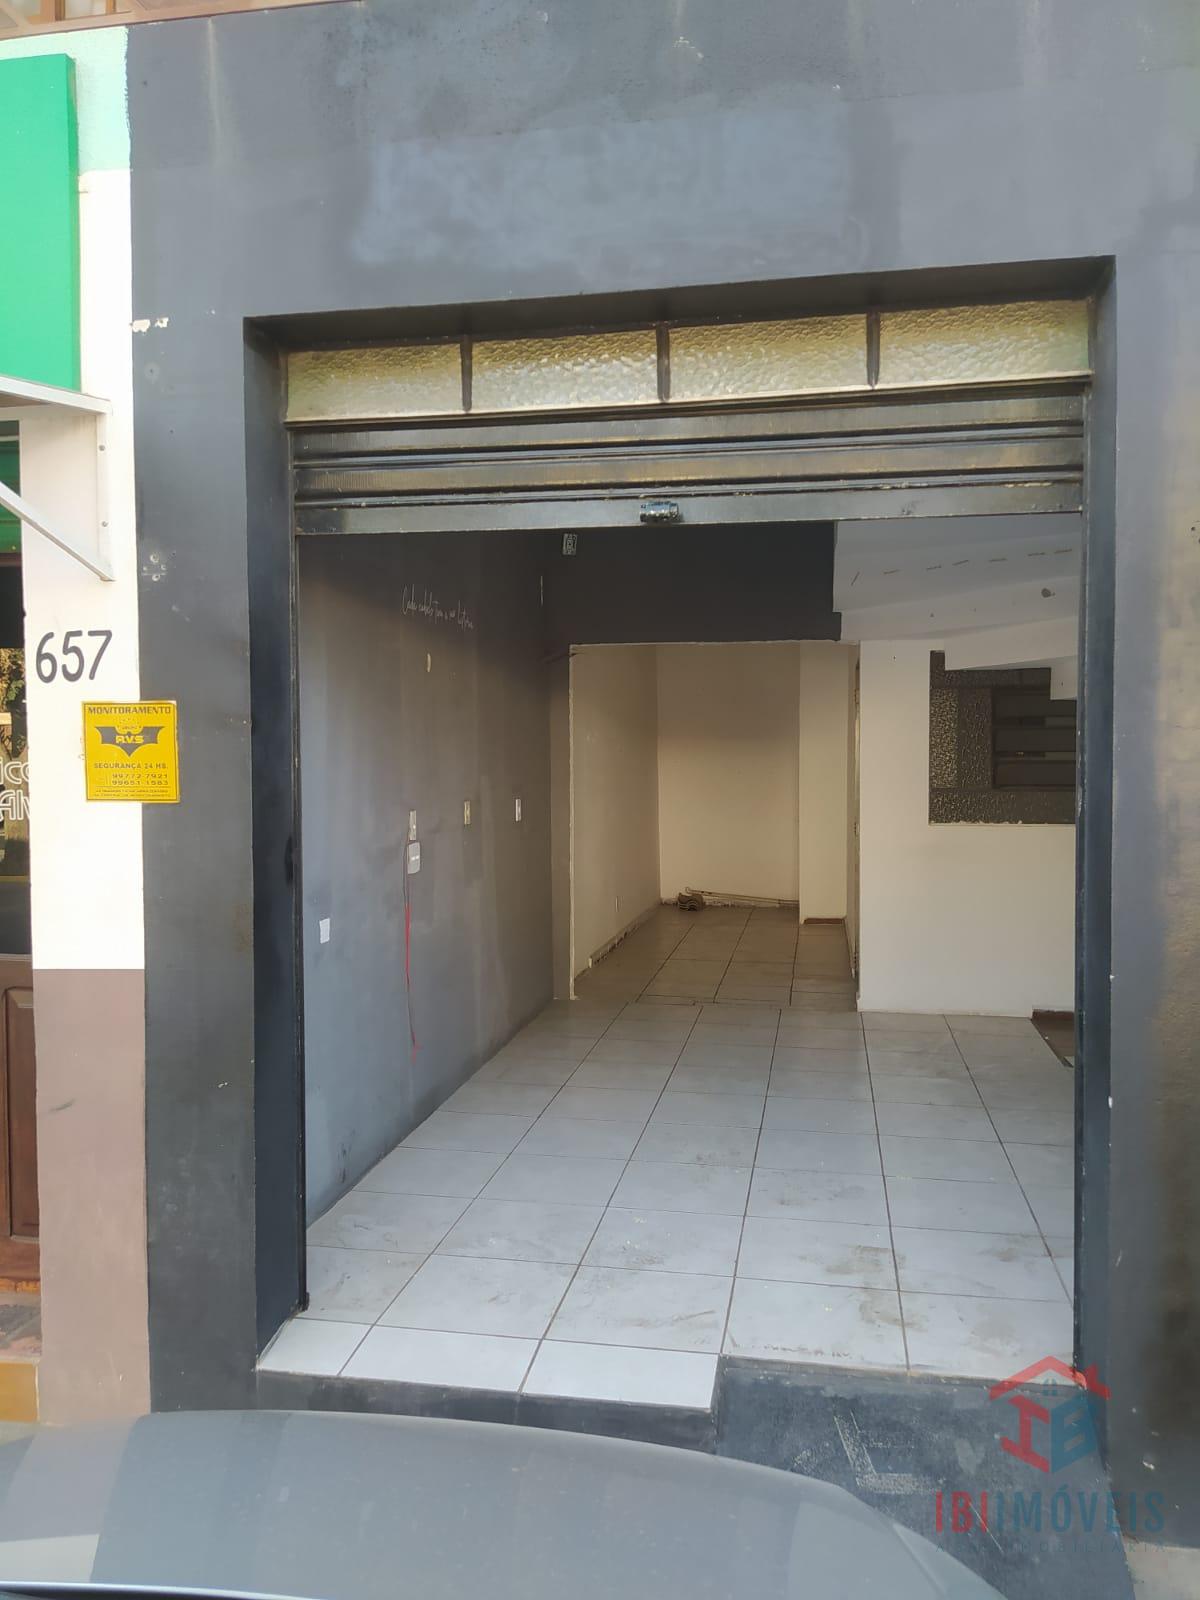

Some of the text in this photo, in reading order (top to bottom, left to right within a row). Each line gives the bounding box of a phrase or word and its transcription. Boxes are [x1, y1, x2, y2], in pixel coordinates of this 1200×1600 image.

[35, 629, 113, 684] 657
[88, 705, 171, 715] MONITORAMENTO
[93, 762, 142, 770] SEGURANÇA
